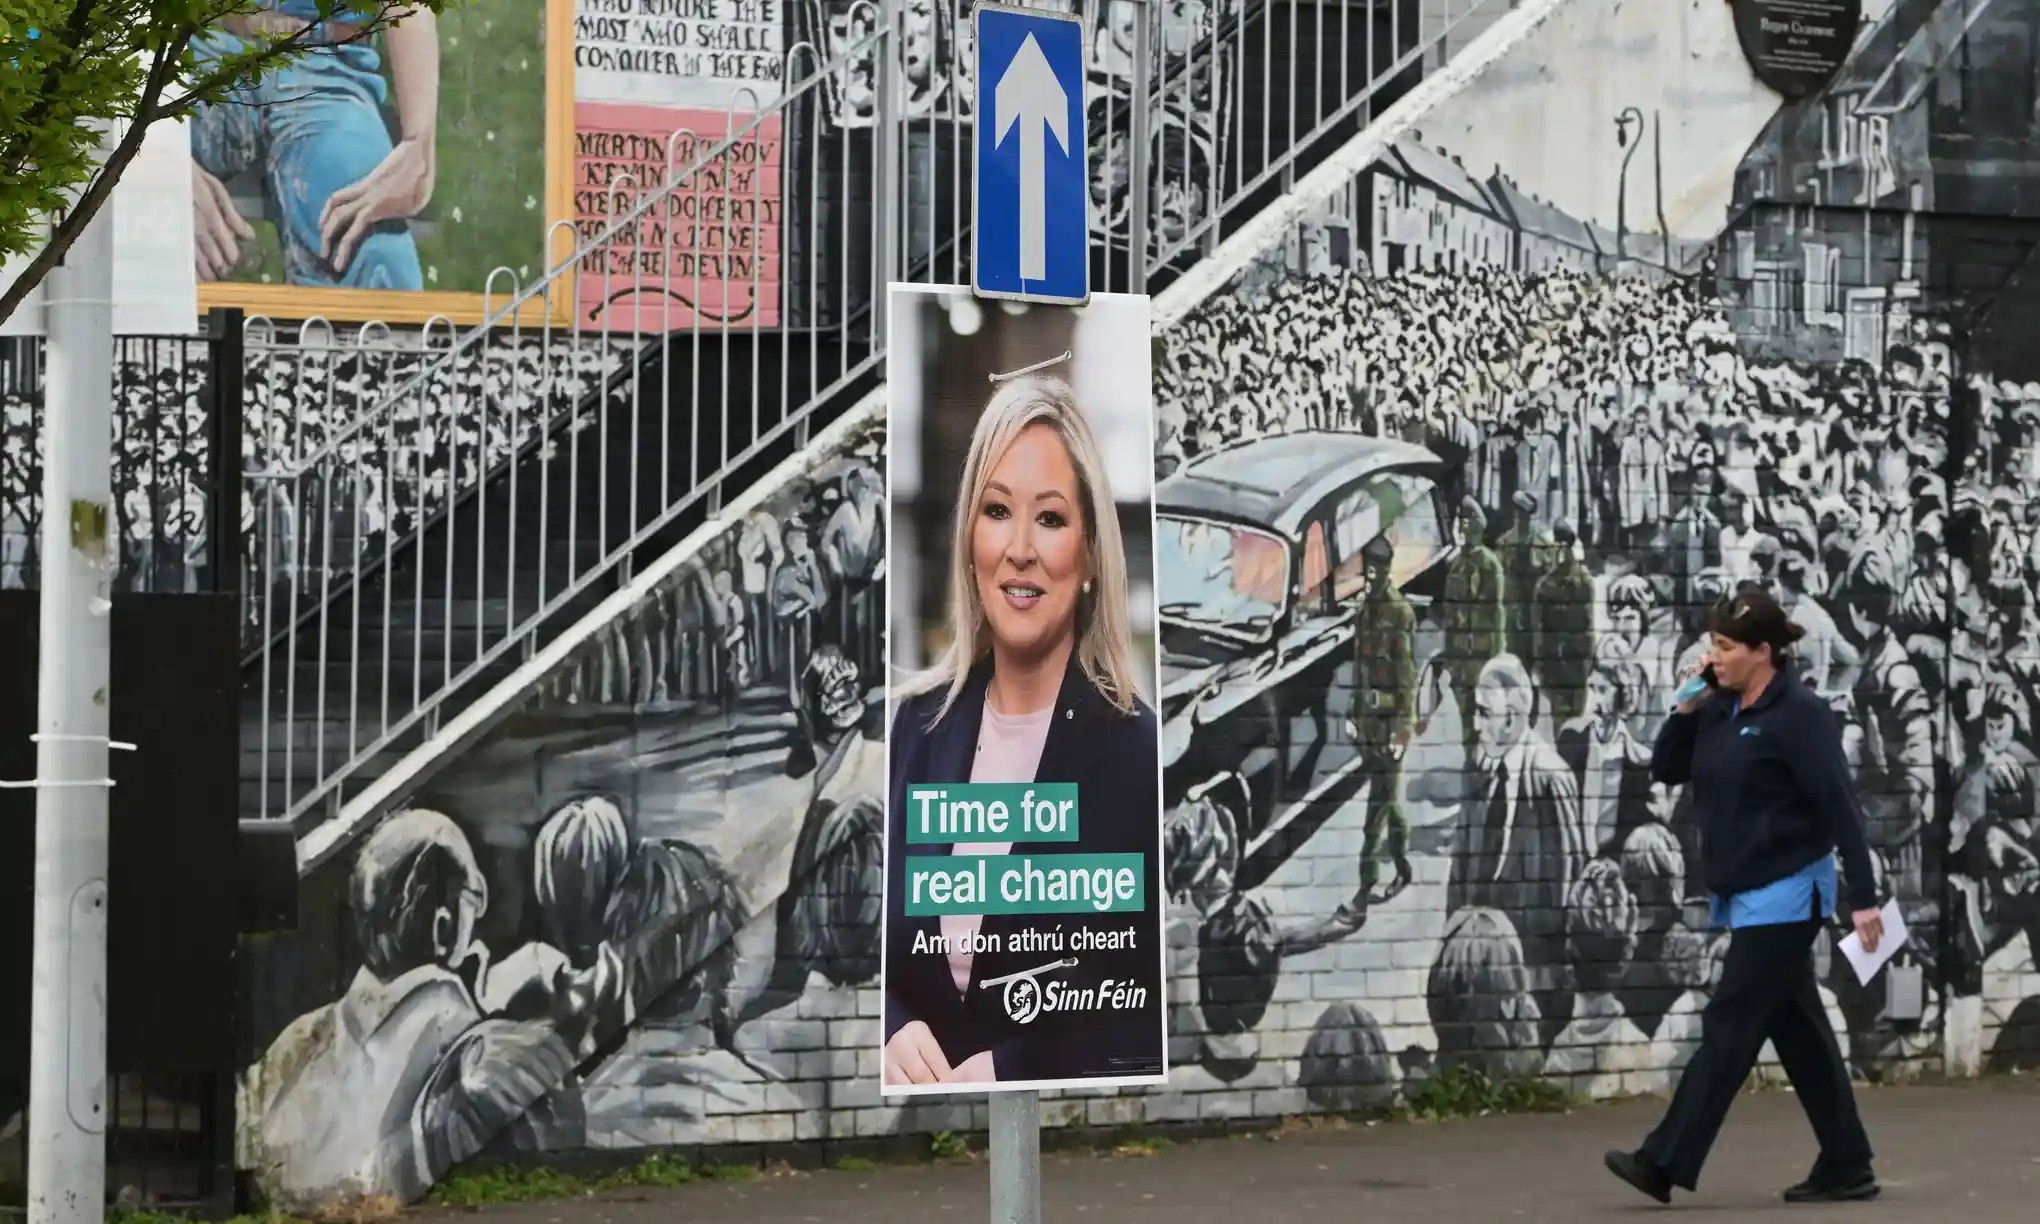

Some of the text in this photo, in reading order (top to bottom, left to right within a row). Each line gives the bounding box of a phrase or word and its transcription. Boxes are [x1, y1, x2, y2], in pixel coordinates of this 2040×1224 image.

[731, 0, 774, 23] THE
[575, 15, 630, 42] MOST
[696, 23, 772, 53] SHALL
[575, 45, 680, 76] CONQUER
[708, 53, 748, 79] THE
[576, 132, 669, 161] MARTIN
[582, 162, 668, 187] KEVIN
[912, 789, 1074, 833] Time for
[912, 858, 1136, 911] real change
[911, 924, 1137, 955] Am don athrú cheart
[1042, 978, 1147, 1012] Sinn Féin
